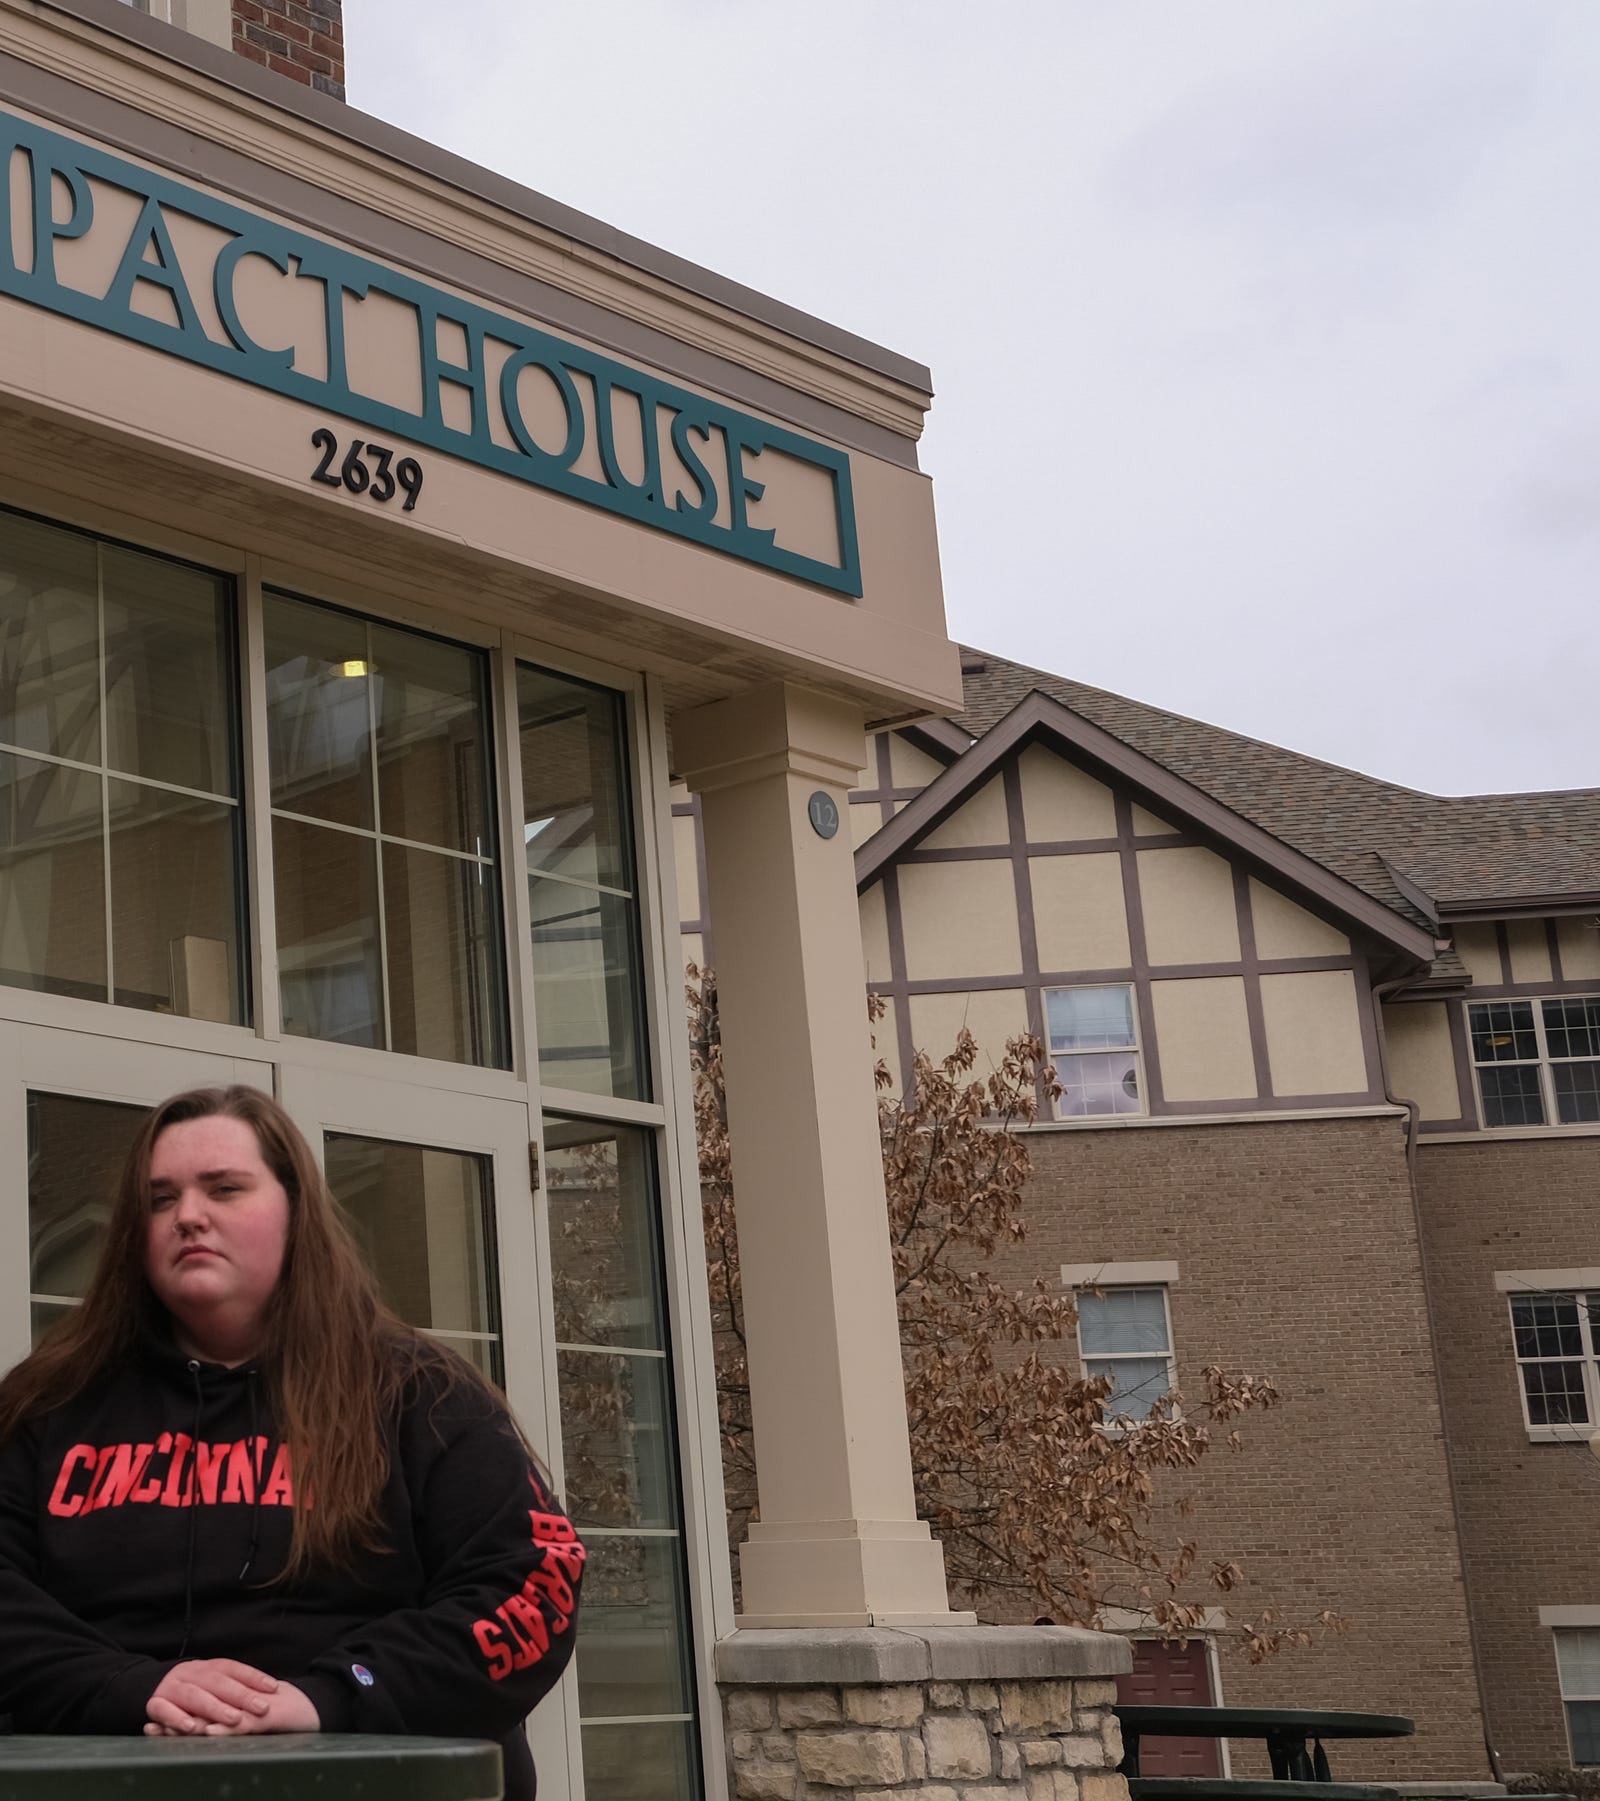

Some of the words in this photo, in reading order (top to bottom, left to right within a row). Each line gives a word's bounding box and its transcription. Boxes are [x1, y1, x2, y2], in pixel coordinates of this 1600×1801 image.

[414, 300, 777, 552] HOUSE
[311, 428, 423, 511] 2639
[813, 802, 837, 828] 12
[48, 1432, 313, 1517] CINCINNA
